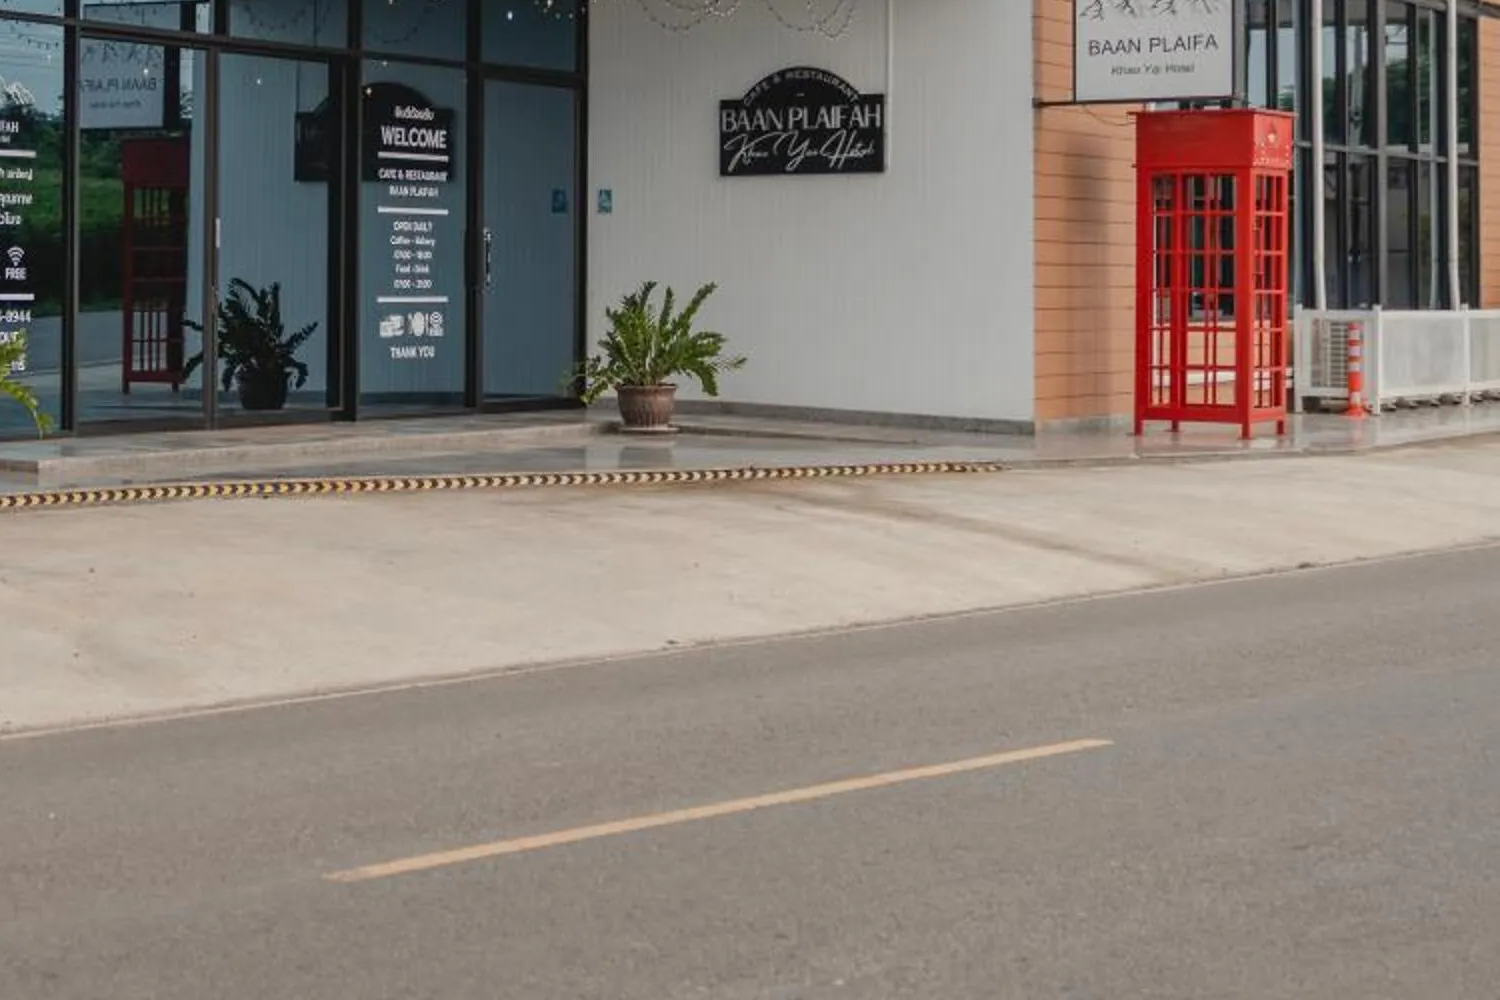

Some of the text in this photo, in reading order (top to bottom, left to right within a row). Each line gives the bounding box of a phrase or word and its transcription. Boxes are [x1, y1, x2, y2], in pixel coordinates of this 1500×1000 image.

[1088, 33, 1219, 56] BAAN PLAIFA
[785, 69, 860, 103] RESTAURANT
[721, 103, 882, 132] BAAN PLAIFAH
[381, 125, 448, 149] WELCOME
[5, 267, 27, 280] FREE
[390, 346, 435, 359] THANK YOU
